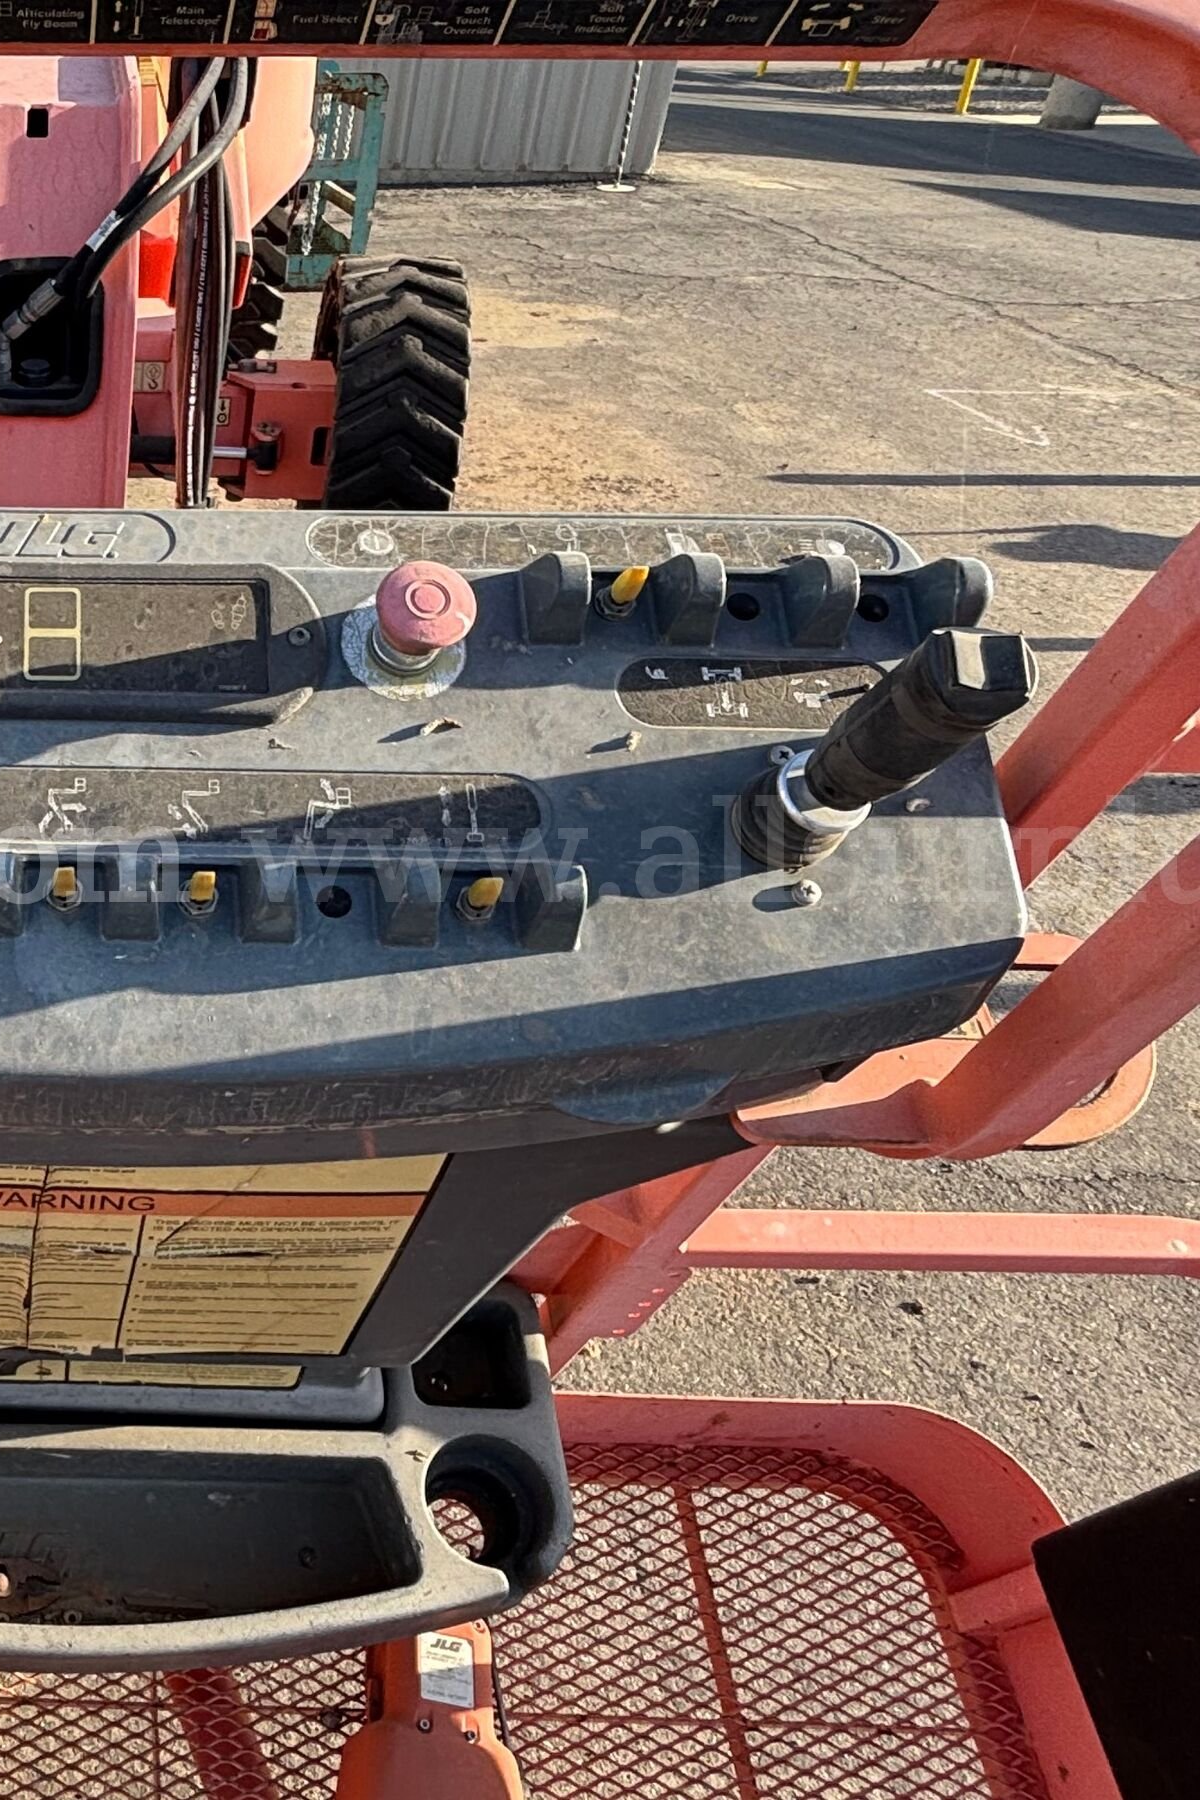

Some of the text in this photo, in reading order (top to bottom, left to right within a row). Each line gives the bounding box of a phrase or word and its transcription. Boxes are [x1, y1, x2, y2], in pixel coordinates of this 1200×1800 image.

[176, 6, 205, 15] Main
[464, 6, 489, 15] Soft
[160, 16, 219, 26] Telescope
[292, 14, 359, 24] Fuel Select
[455, 16, 491, 25] Touch
[725, 14, 759, 23] Drive
[22, 20, 78, 30] Fly Boom
[574, 25, 628, 33] Indicator
[443, 26, 494, 35] Override
[430, 1638, 463, 1653] JLG
